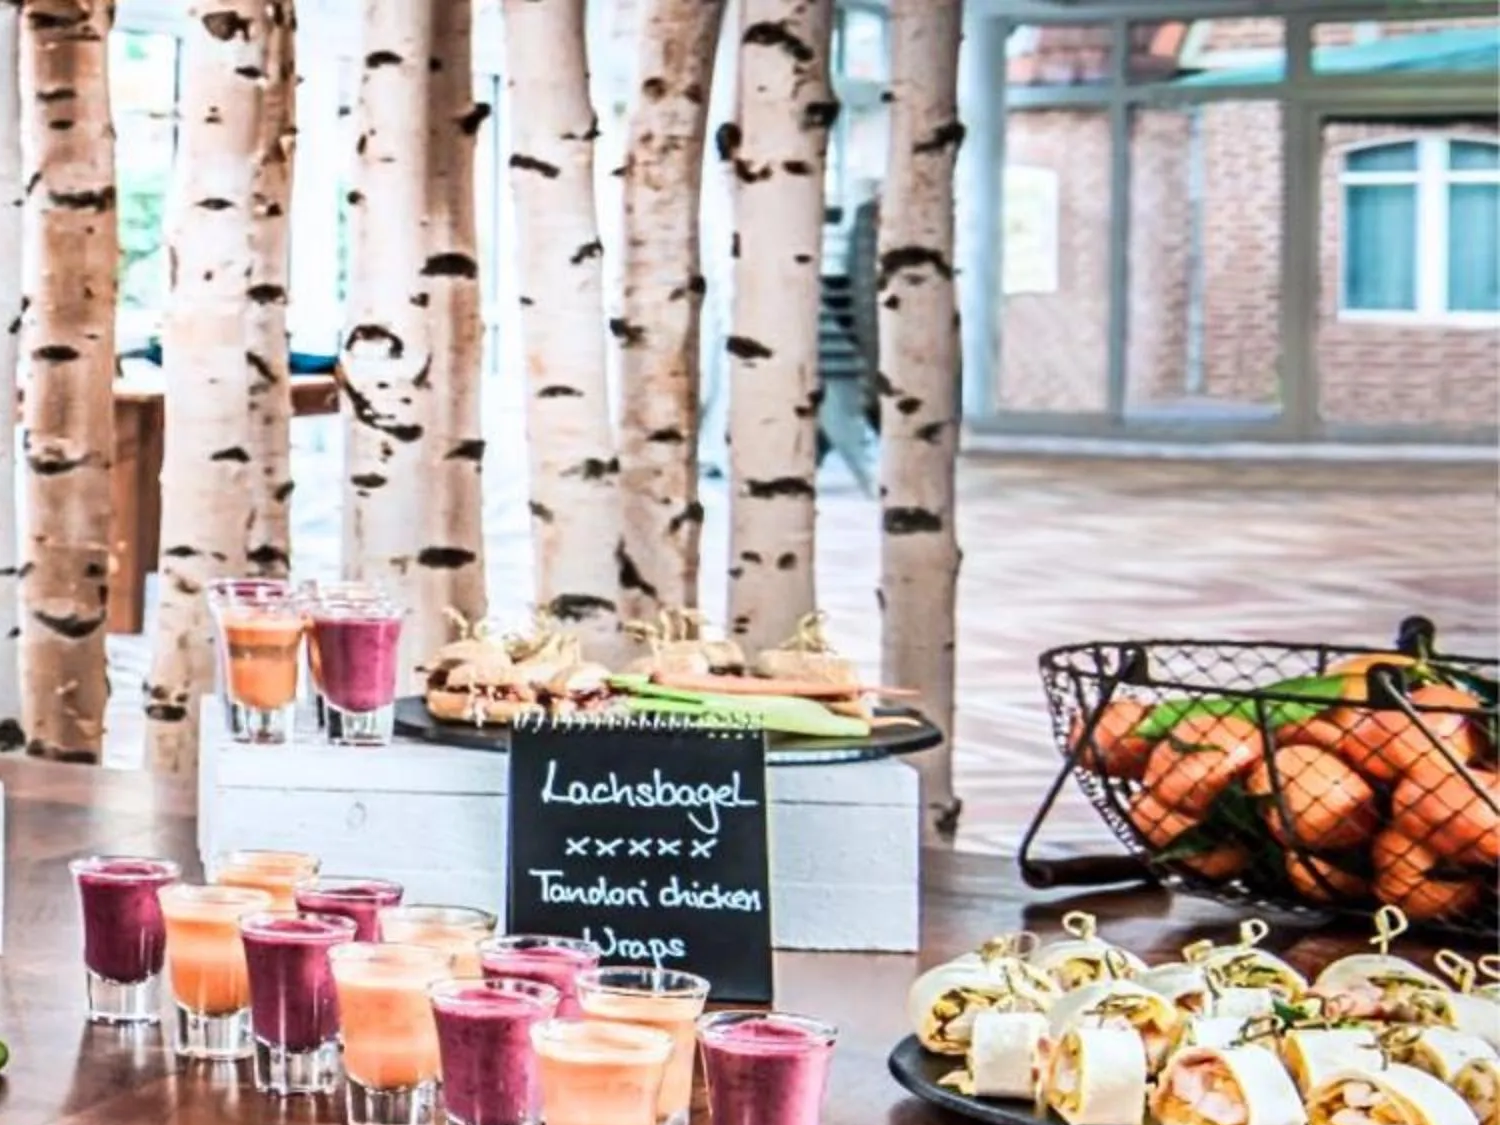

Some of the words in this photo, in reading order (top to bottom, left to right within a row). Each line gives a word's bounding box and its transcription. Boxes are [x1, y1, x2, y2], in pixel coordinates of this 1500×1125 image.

[541, 760, 760, 835] Lachsbagel
[528, 869, 650, 908] Tandori
[659, 875, 762, 911] chicken
